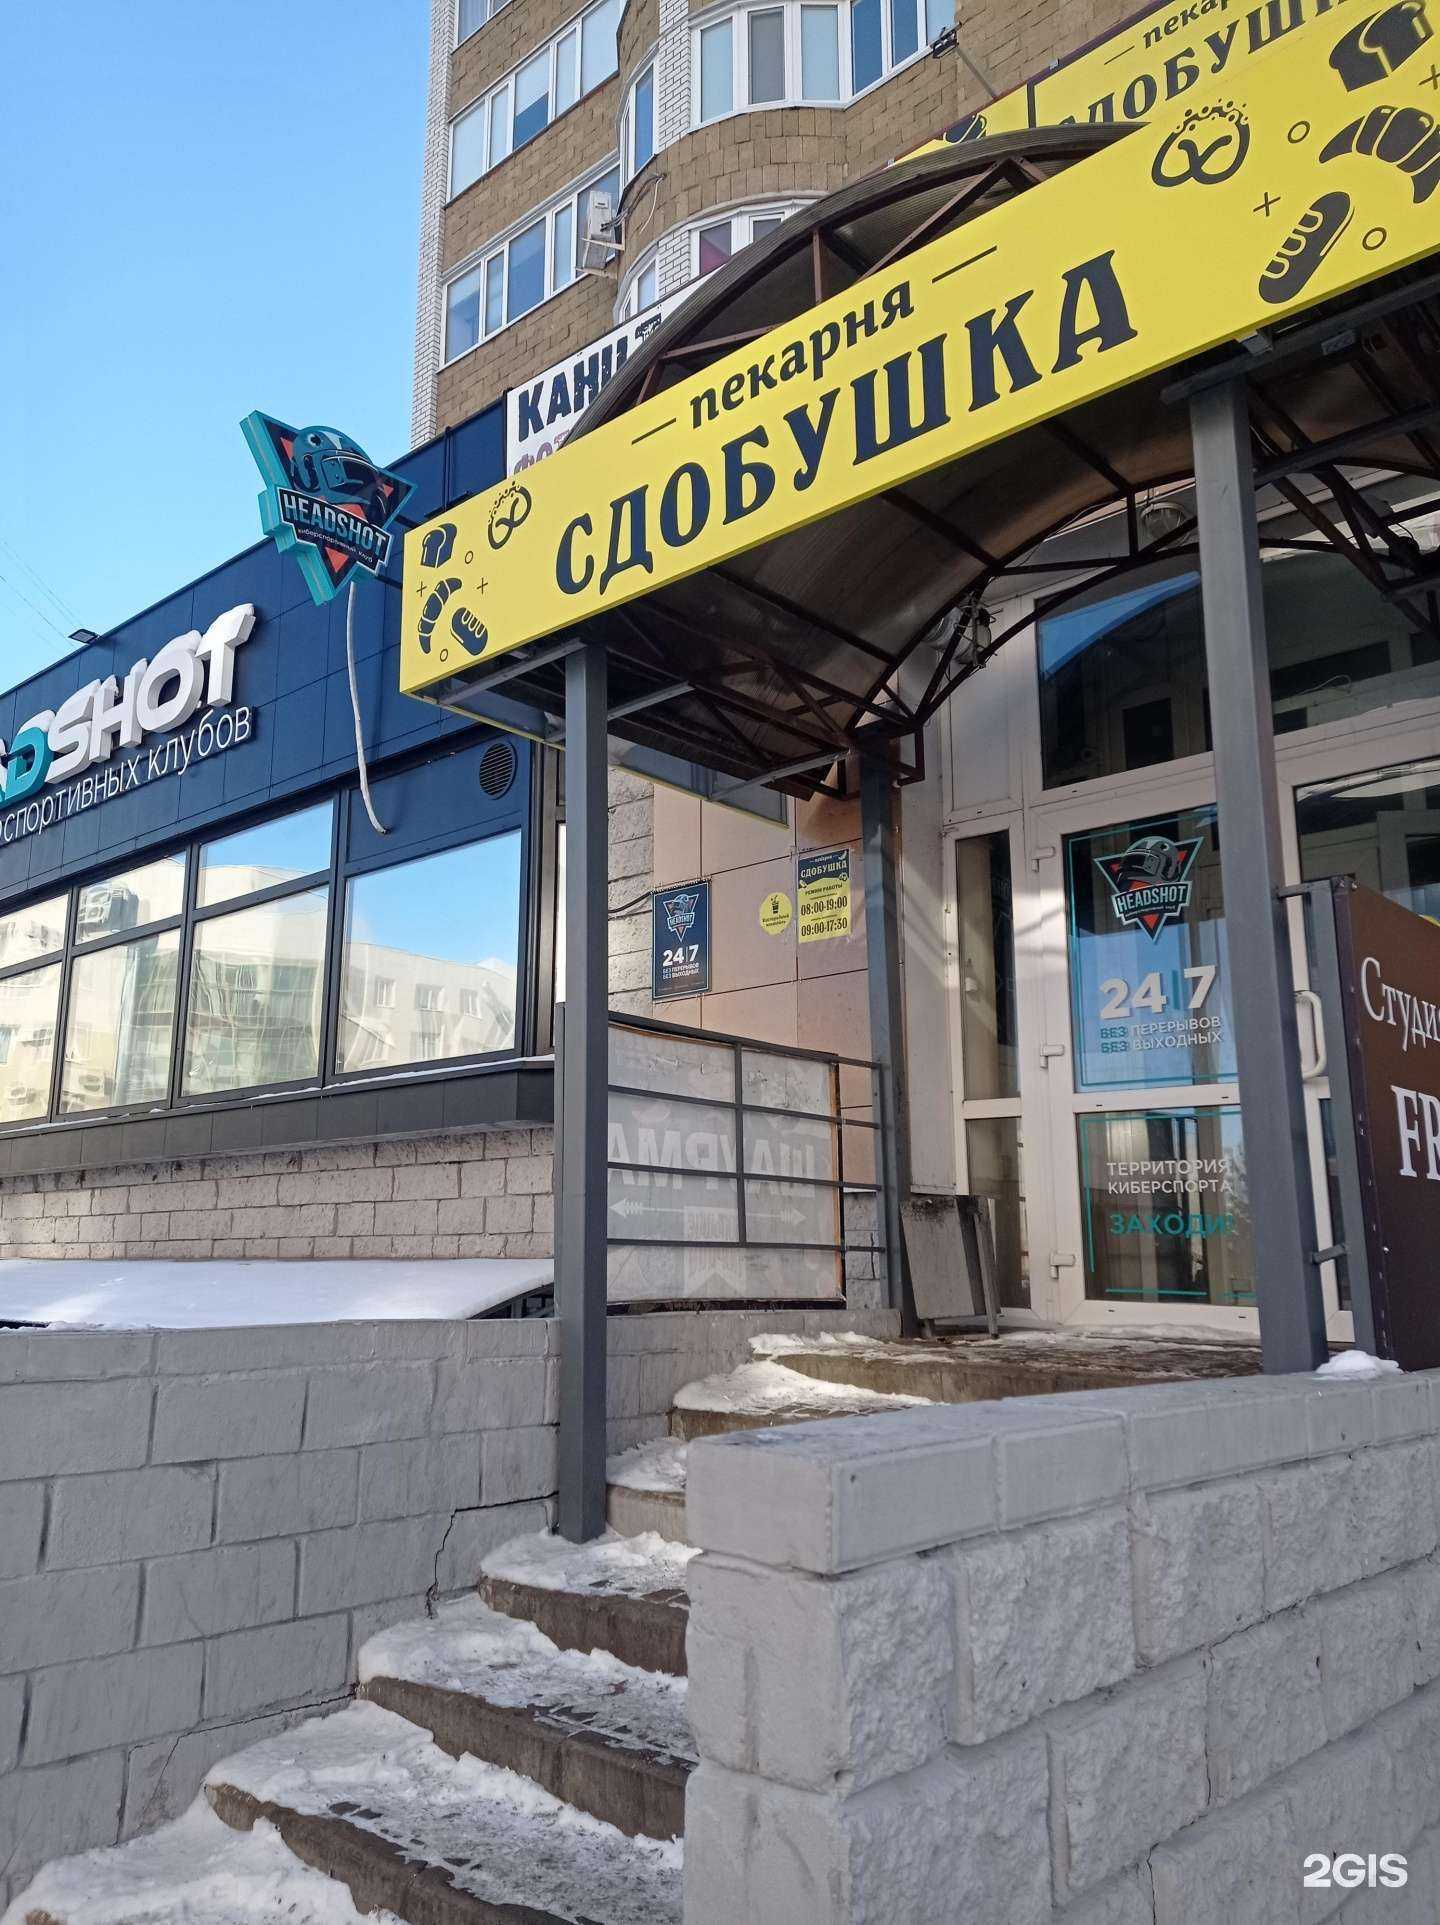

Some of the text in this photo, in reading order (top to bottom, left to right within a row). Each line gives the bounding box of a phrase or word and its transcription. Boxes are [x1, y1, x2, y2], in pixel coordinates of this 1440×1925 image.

[691, 281, 915, 428] пекарня
[555, 250, 1138, 595] СДОБУШКА
[283, 493, 386, 556] HEADSHOT
[0, 755, 140, 842] спортивных
[800, 860, 847, 878] СДОБУШКА
[1117, 886, 1187, 912] HEADSHOT
[1361, 956, 1440, 1051] Студи
[1101, 1016, 1221, 1039] БЕЗ ПЕРЕРЫВОВ
[1101, 1031, 1222, 1054] БЕЗ ВЫХОДНЫХ
[1106, 1159, 1231, 1176] ТЕРРИТОРИЯ
[1108, 1179, 1233, 1195] КИБЕРСПОРТА
